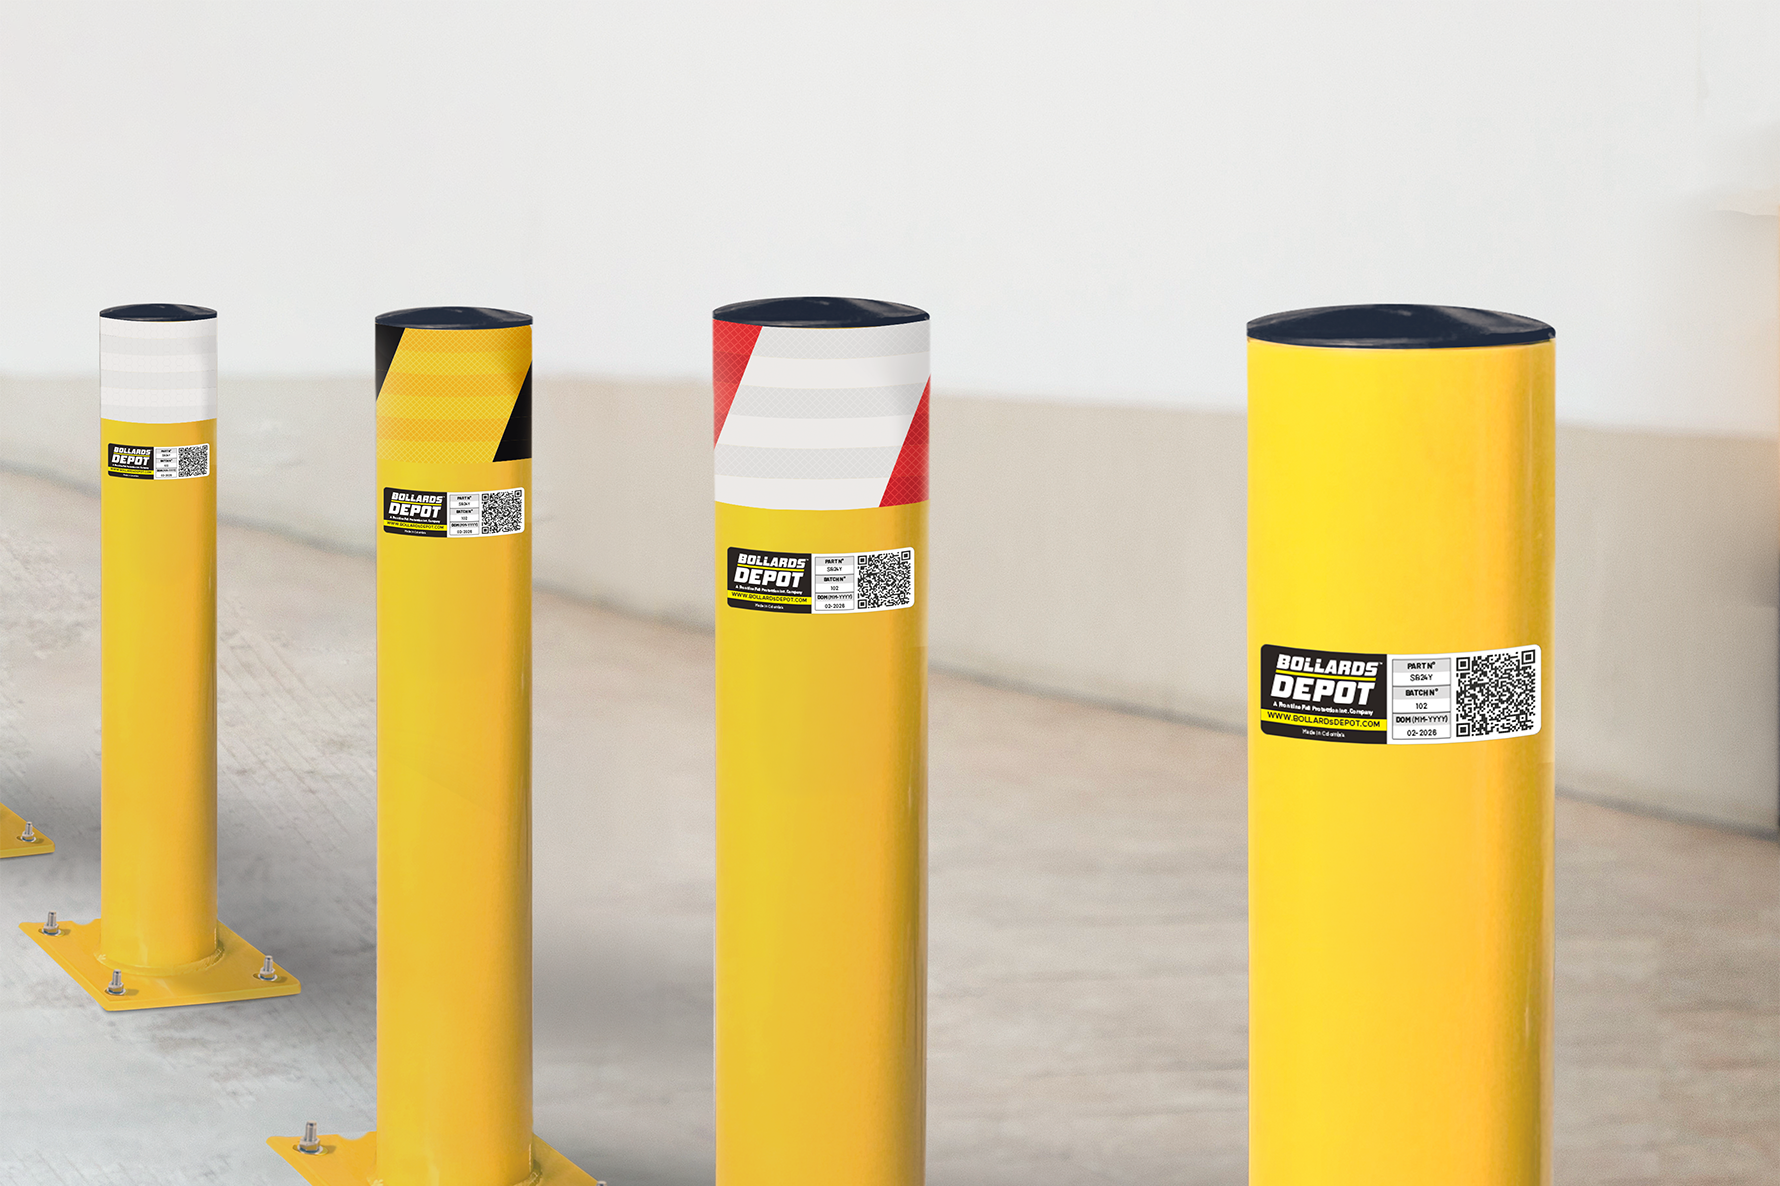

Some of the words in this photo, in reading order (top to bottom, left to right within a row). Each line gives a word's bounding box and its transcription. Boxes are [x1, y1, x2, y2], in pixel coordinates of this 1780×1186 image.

[114, 447, 151, 455] BOLLARDS
[112, 454, 150, 465] DEPOT
[392, 492, 443, 504] BOLLARDS
[389, 502, 442, 518] DEPOT
[738, 553, 806, 568] BOLLARDS
[734, 566, 804, 588] DEPOT
[1276, 653, 1379, 676] BOLLARDS
[1270, 674, 1376, 705] DEPOT
